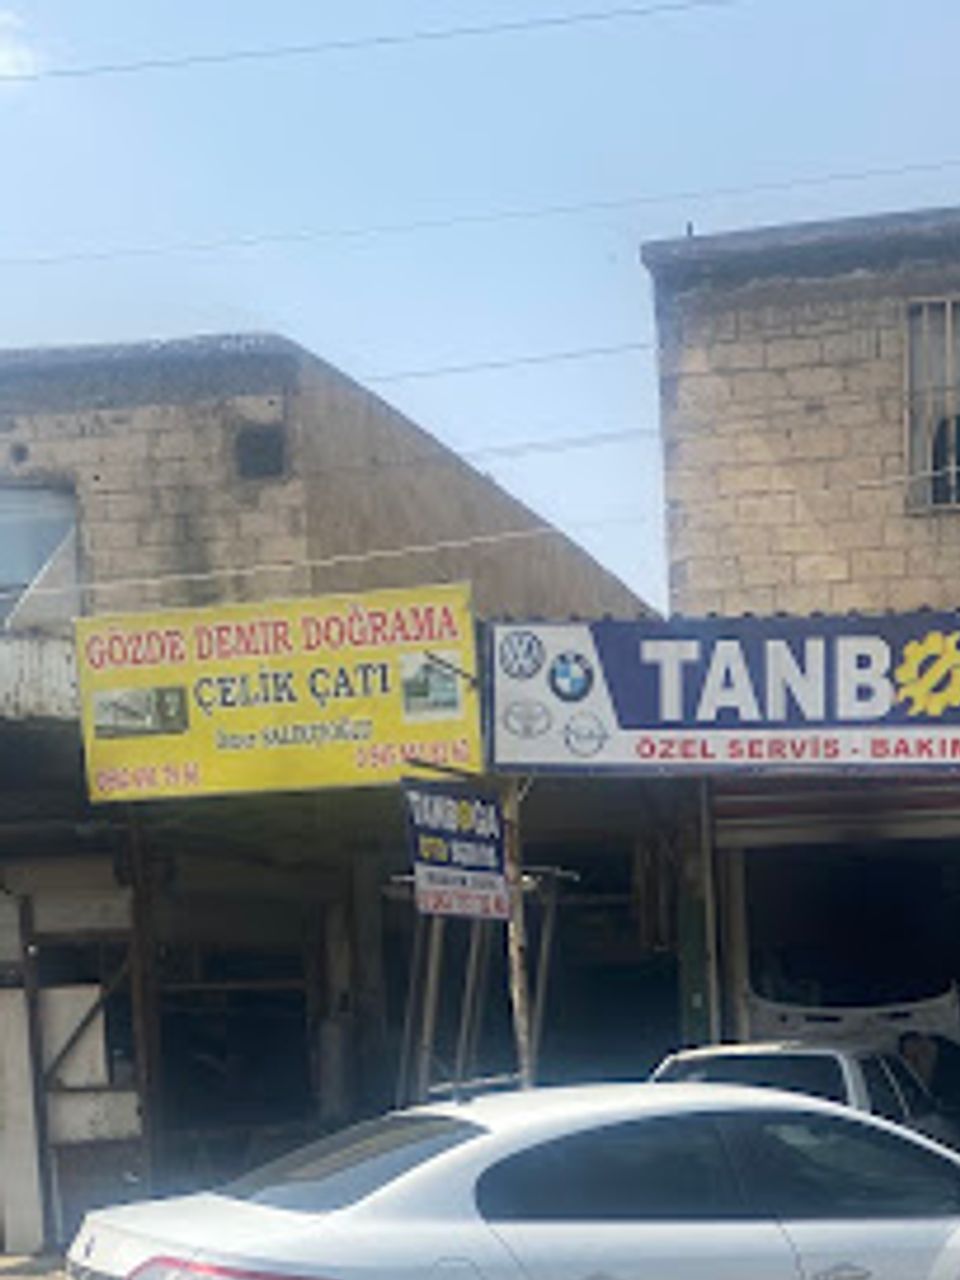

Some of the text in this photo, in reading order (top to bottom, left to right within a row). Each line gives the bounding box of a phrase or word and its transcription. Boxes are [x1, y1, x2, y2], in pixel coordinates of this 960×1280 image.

[86, 624, 186, 671] GÖZDE
[302, 603, 458, 652] DOĞRAMA
[192, 661, 391, 716] ÇELİK ÇATI
[635, 735, 717, 760] ÖZEL
[727, 734, 841, 760] SERVİS
